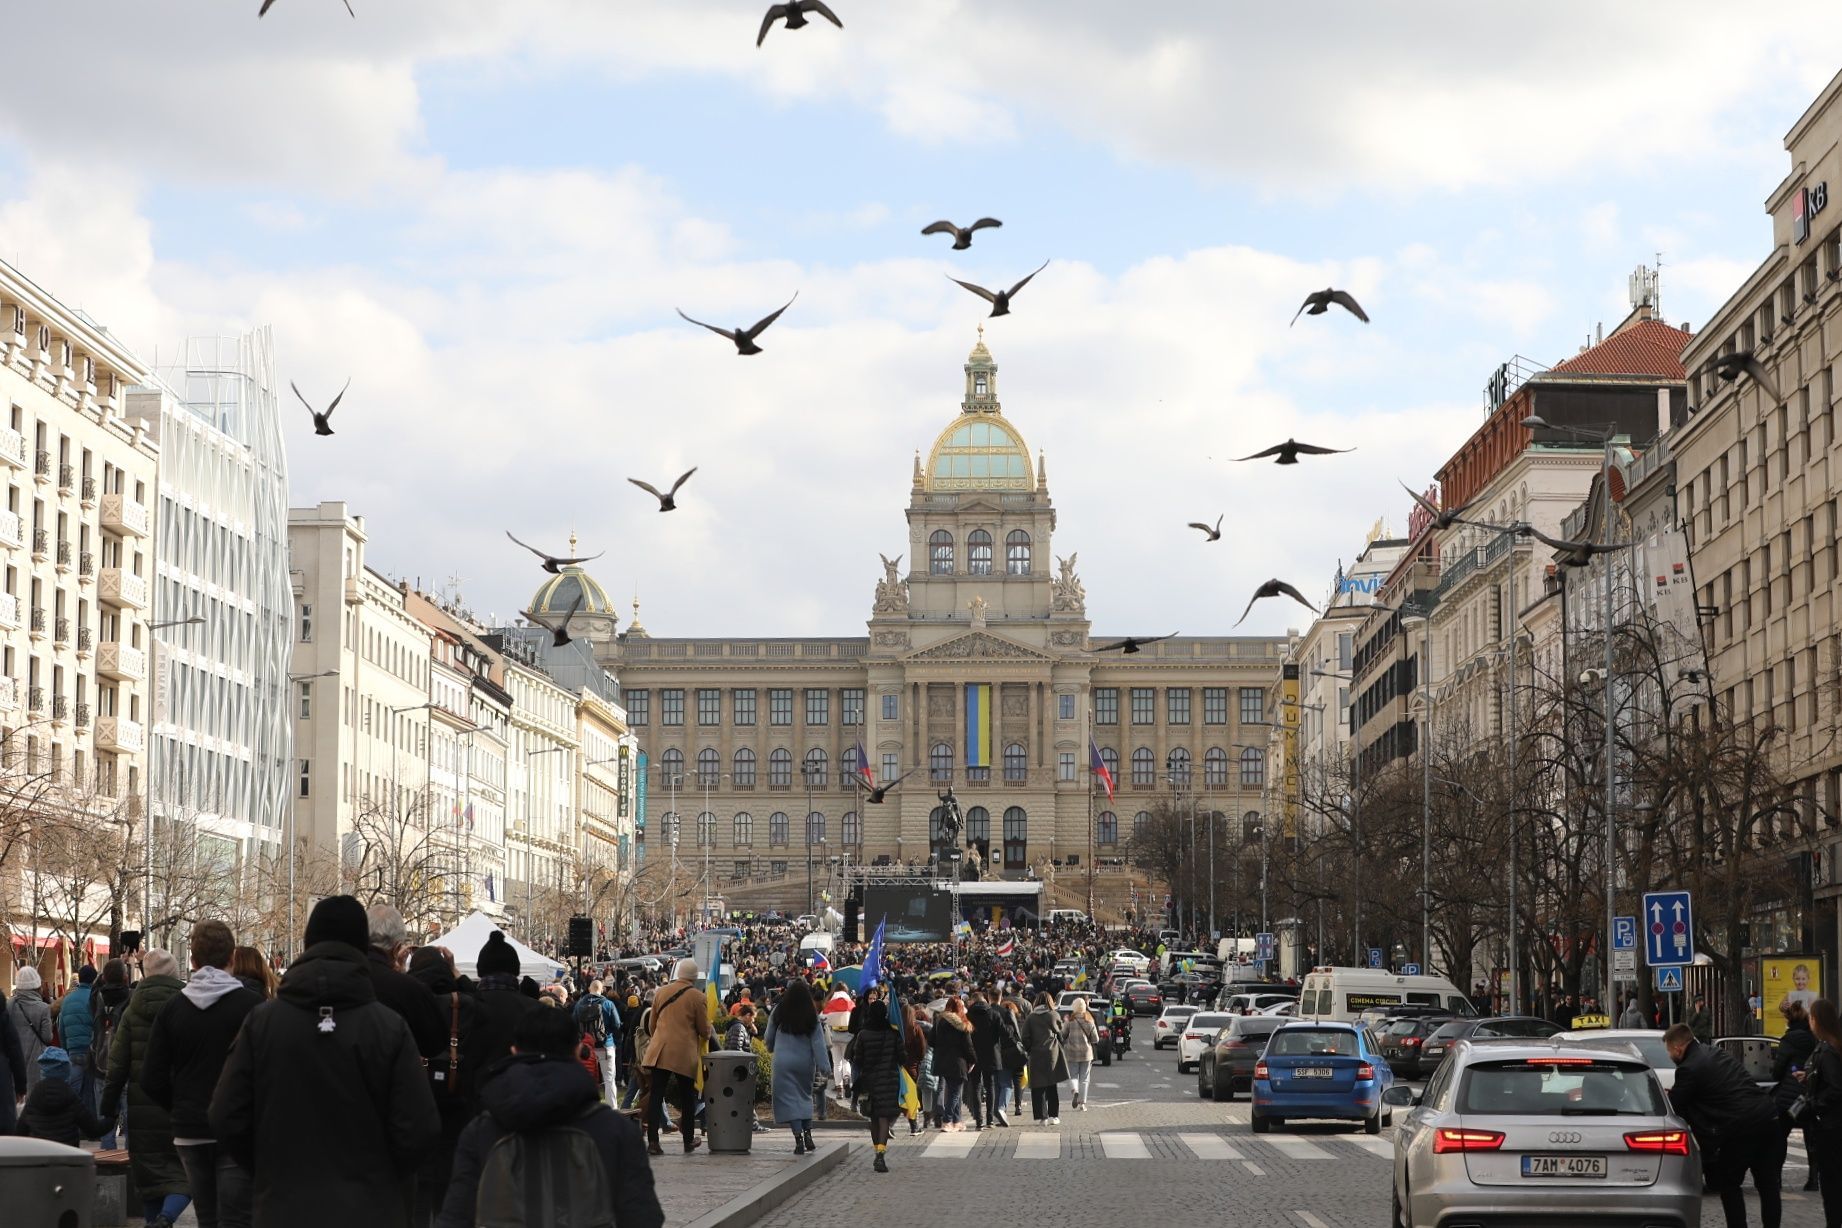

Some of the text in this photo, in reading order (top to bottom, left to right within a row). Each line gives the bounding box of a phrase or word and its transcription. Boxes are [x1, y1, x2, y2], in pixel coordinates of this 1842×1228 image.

[1808, 182, 1826, 220] KB
[14, 304, 116, 400] HOTEL
[1673, 576, 1688, 585] KB
[1656, 588, 1671, 596] KB
[158, 654, 166, 708] PRIMARK
[1617, 921, 1630, 939] P
[1578, 1015, 1605, 1024] TAXI
[1296, 1068, 1309, 1076] 5SF
[1533, 1158, 1600, 1172] 7AM 4076
